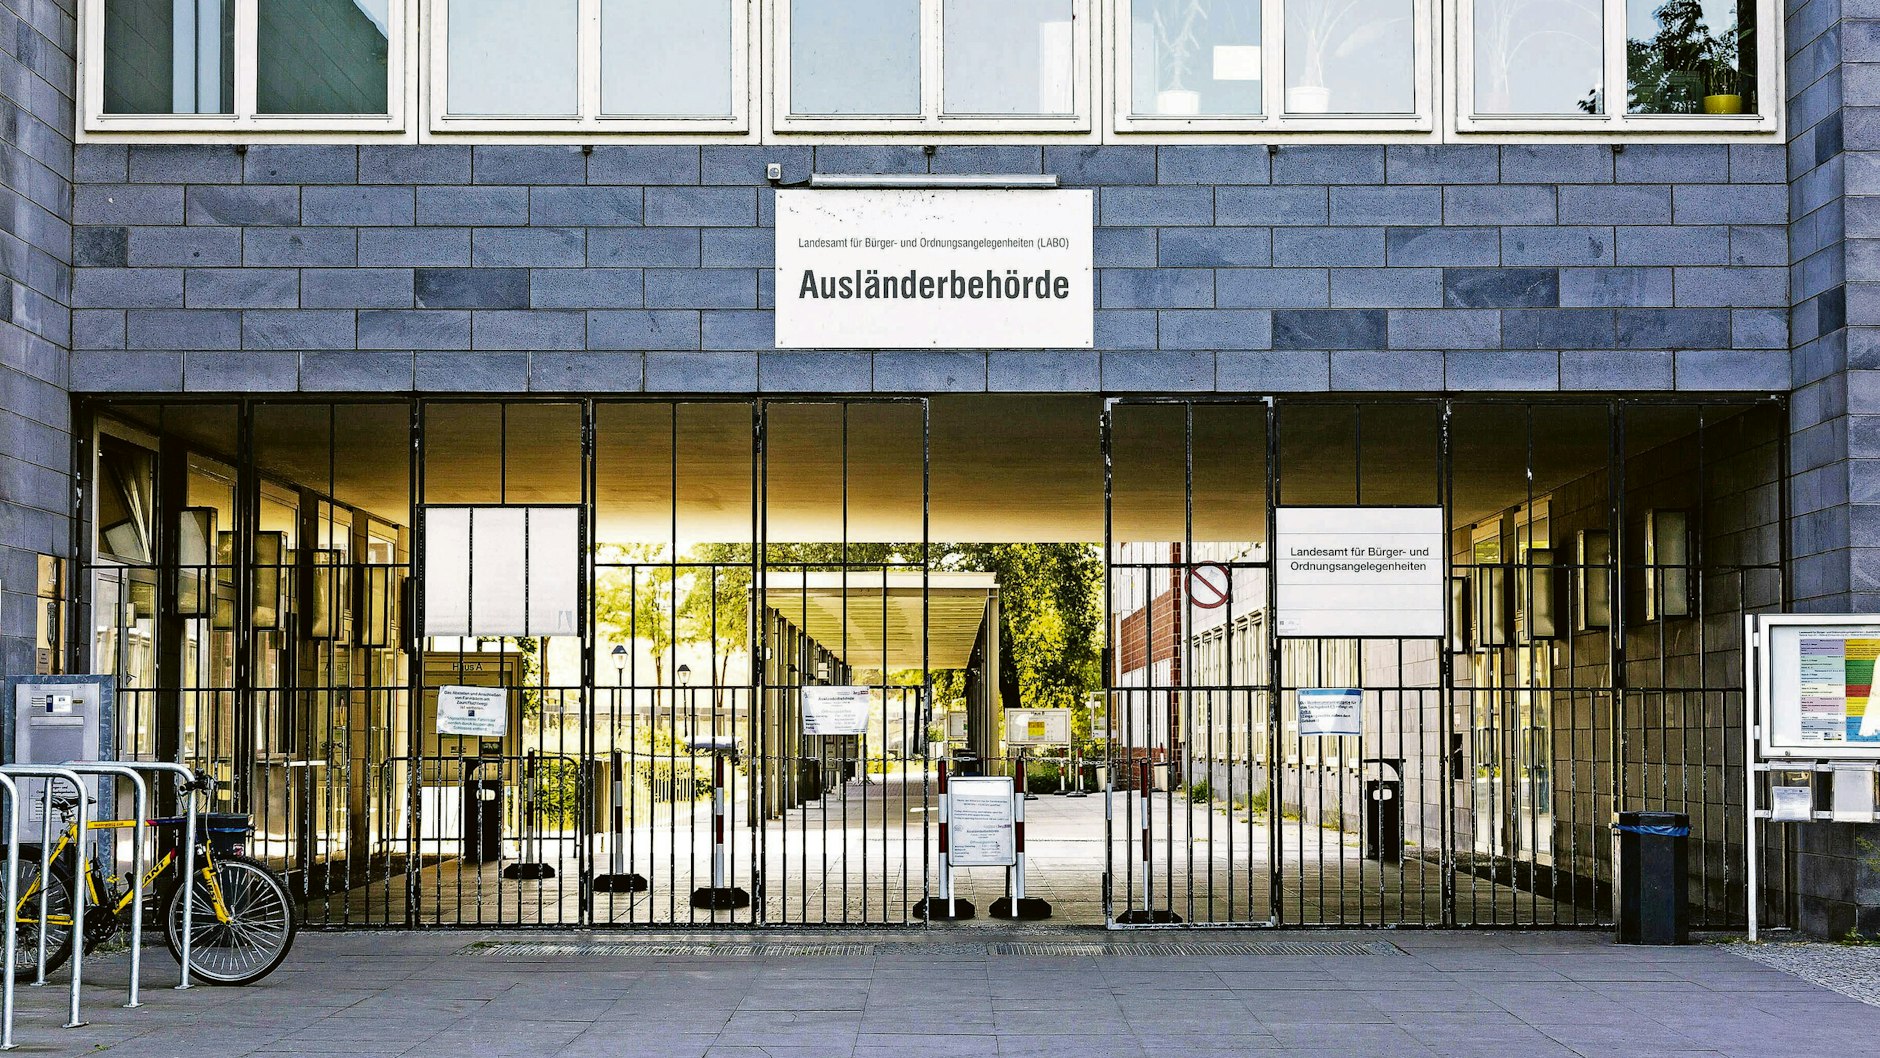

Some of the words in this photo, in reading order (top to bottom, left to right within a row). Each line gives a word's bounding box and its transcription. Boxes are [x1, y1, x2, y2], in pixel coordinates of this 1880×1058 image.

[798, 238, 848, 248] Landesamt
[850, 237, 863, 248] für
[864, 237, 898, 250] Bürger-
[900, 238, 917, 248] und
[919, 237, 1034, 250] Ordnungsangelegenheiten
[1037, 237, 1069, 250] (LABO)
[799, 269, 1069, 299] Ausländerbehörde
[1290, 547, 1348, 557] Landesamt
[1350, 547, 1366, 557] für
[1368, 547, 1407, 559] Bürger-
[1409, 547, 1429, 557] und
[1290, 561, 1427, 573] Ordnungsangelegenheiten
[452, 662, 475, 671] Hus
[476, 662, 483, 671] A
